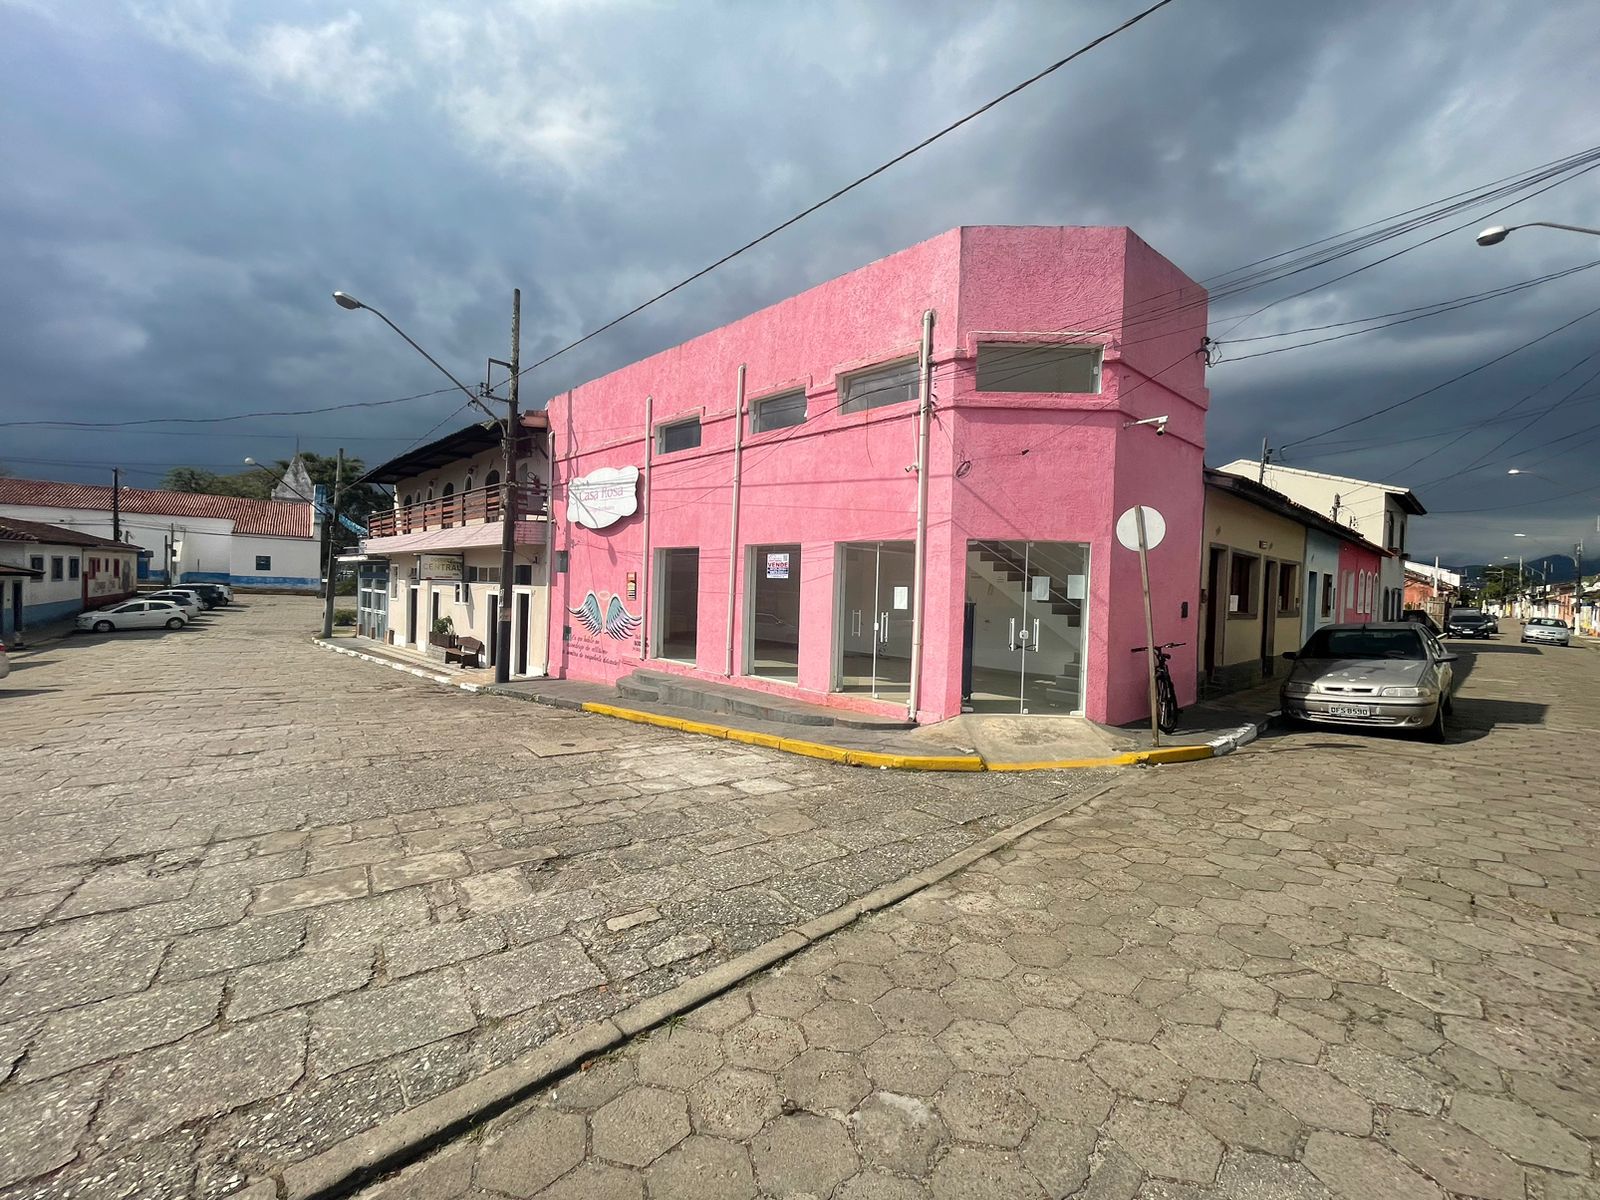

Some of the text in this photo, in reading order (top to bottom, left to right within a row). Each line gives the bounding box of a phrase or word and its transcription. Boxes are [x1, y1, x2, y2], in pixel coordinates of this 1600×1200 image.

[579, 486, 624, 502] Casa Rosa
[423, 563, 461, 571] CENTRAL
